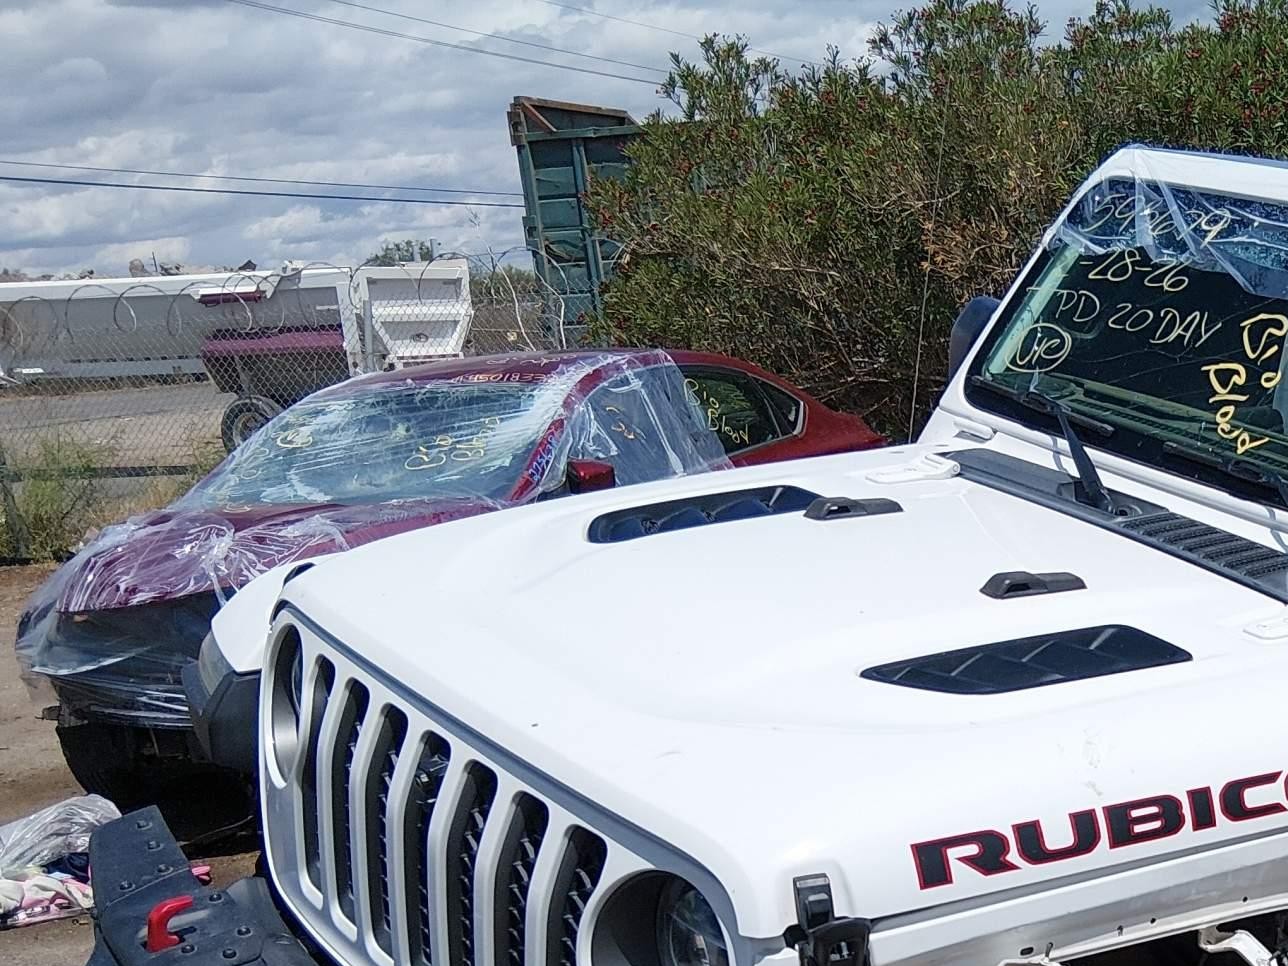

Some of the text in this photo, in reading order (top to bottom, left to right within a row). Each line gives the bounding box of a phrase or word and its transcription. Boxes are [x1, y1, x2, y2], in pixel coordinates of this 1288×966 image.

[1107, 302, 1154, 333] 20
[1149, 308, 1223, 347] DAY
[683, 378, 720, 409] Bio
[707, 408, 750, 445] Blood
